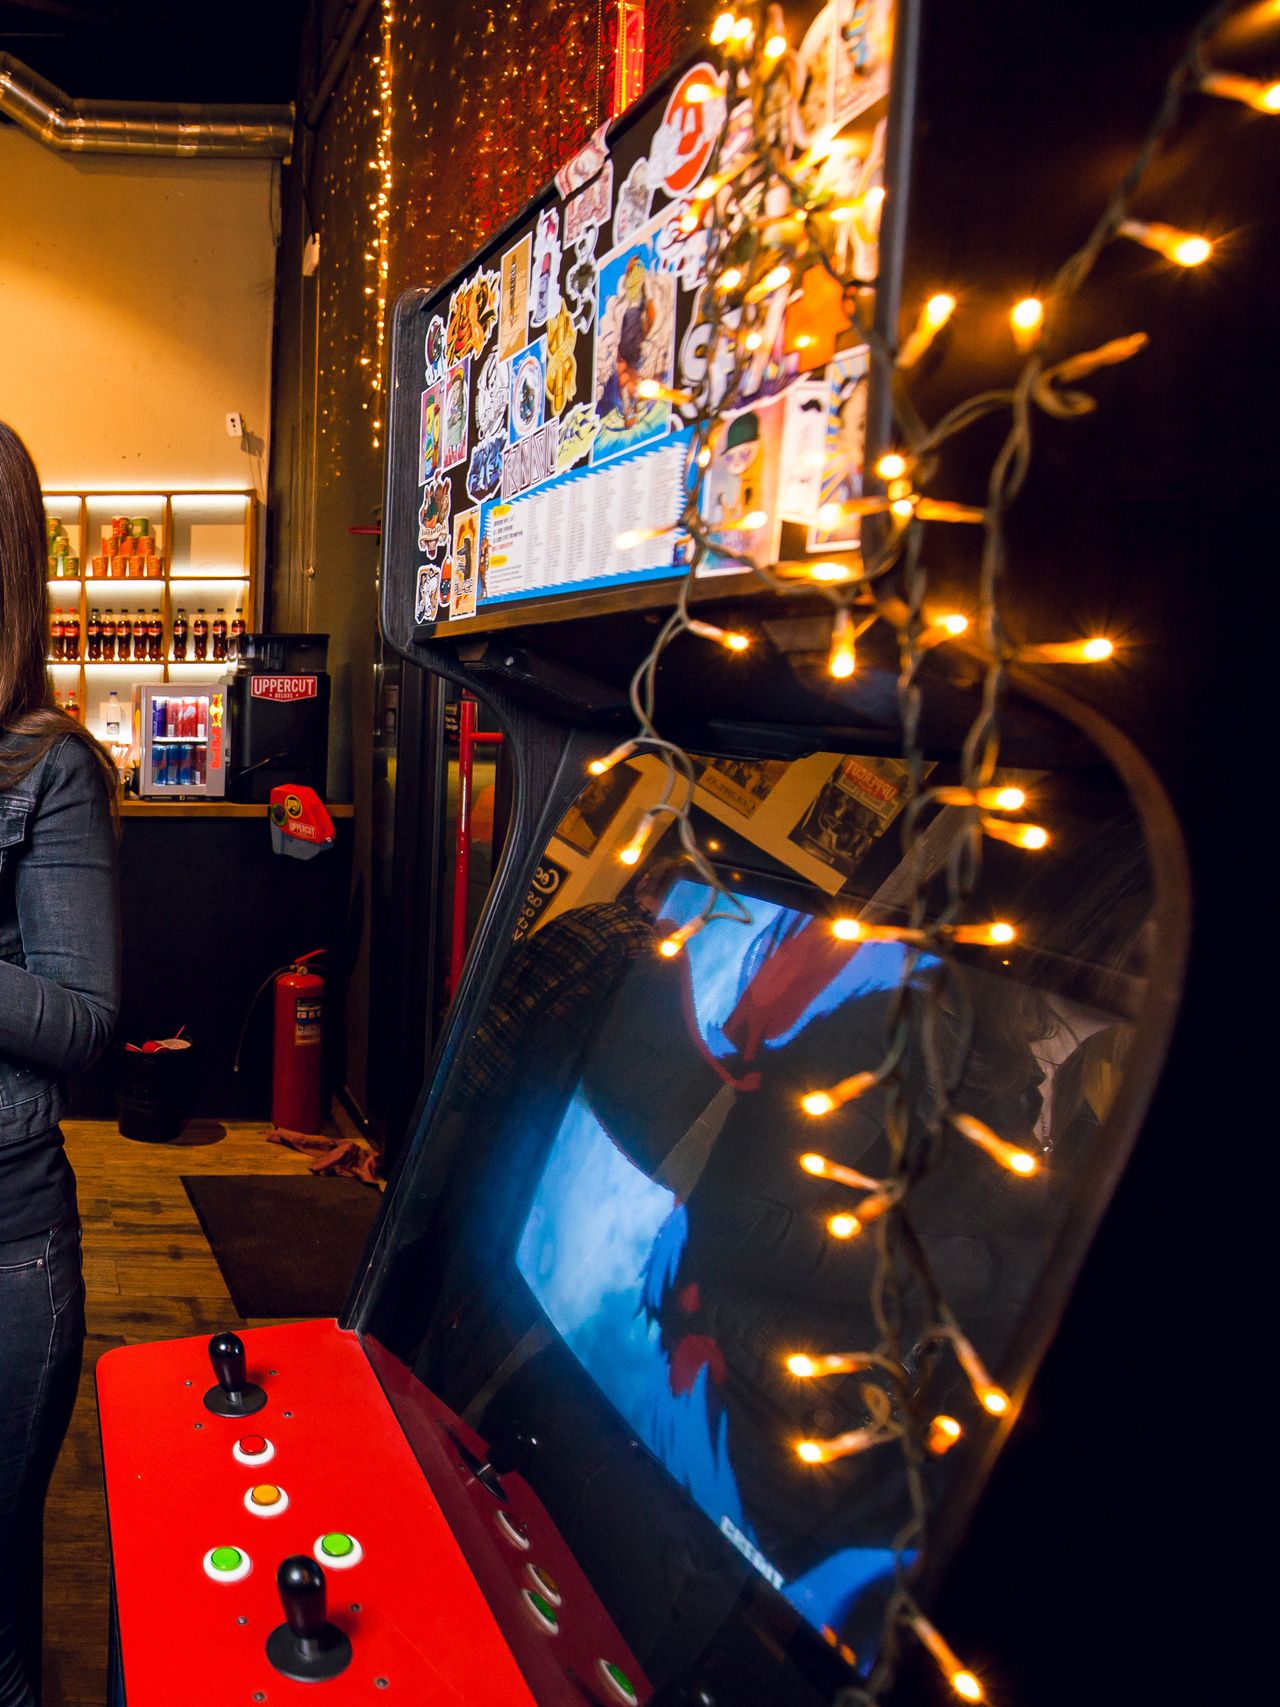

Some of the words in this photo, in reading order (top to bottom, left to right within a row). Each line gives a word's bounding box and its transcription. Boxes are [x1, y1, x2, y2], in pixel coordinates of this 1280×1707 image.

[253, 678, 315, 695] UPPERCUT
[210, 727, 222, 747] Bull
[210, 747, 222, 769] Red
